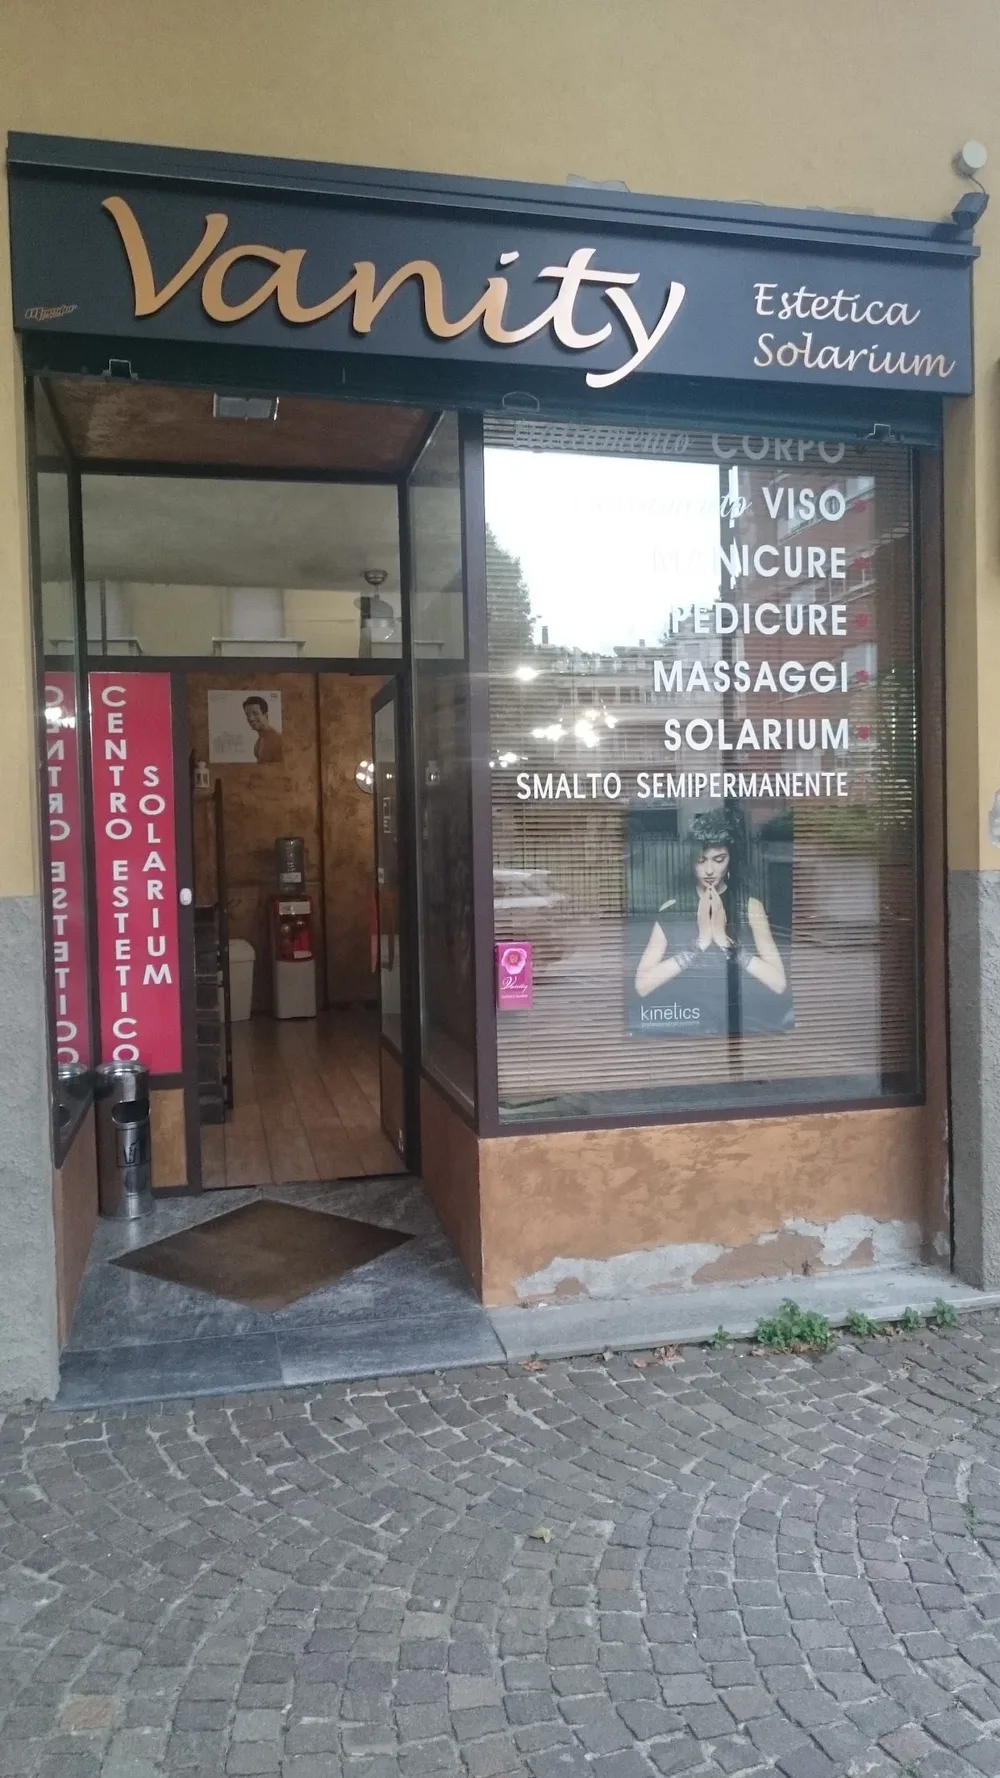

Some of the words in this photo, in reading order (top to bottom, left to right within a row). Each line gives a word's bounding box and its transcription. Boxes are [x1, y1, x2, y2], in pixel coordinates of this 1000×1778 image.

[102, 196, 686, 389] Vanity
[753, 282, 921, 327] Estetica
[753, 332, 956, 379] Solarium
[762, 486, 847, 522] VISO
[671, 602, 847, 636] PEDICURE
[653, 660, 848, 694] MASSAGGI
[664, 717, 848, 752] SOLARIUM
[100, 685, 133, 841] CENTRO
[516, 772, 622, 800] SMALTO
[636, 772, 849, 799] SEMIPERMANENTE
[138, 764, 173, 986] SOLARIUM
[112, 859, 140, 1061] ESTETICO
[640, 1001, 701, 1021] kinetics
